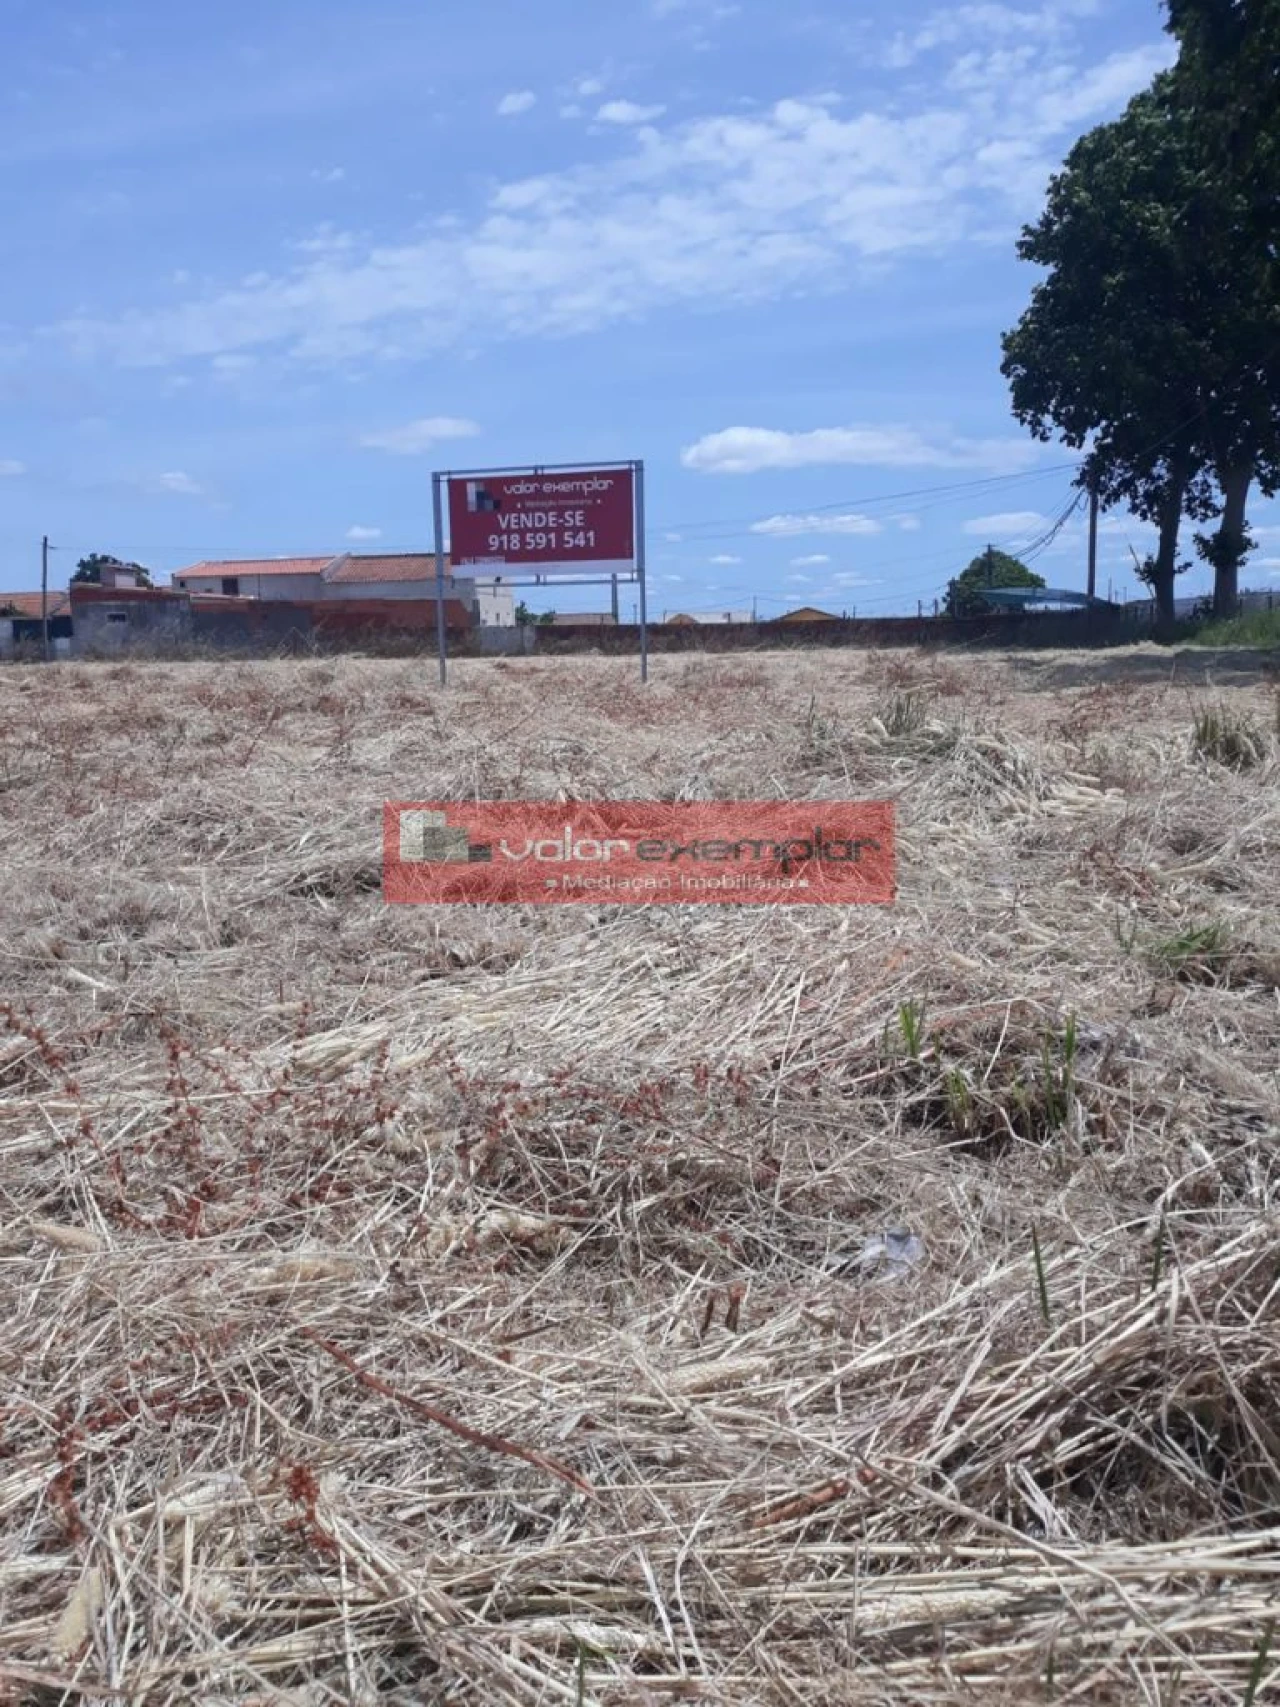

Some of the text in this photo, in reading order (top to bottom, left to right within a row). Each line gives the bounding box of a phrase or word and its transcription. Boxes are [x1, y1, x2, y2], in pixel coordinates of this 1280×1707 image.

[503, 476, 614, 495] valor exemplar
[497, 510, 586, 529] VENDE-SE
[488, 530, 596, 551] 918 591 541
